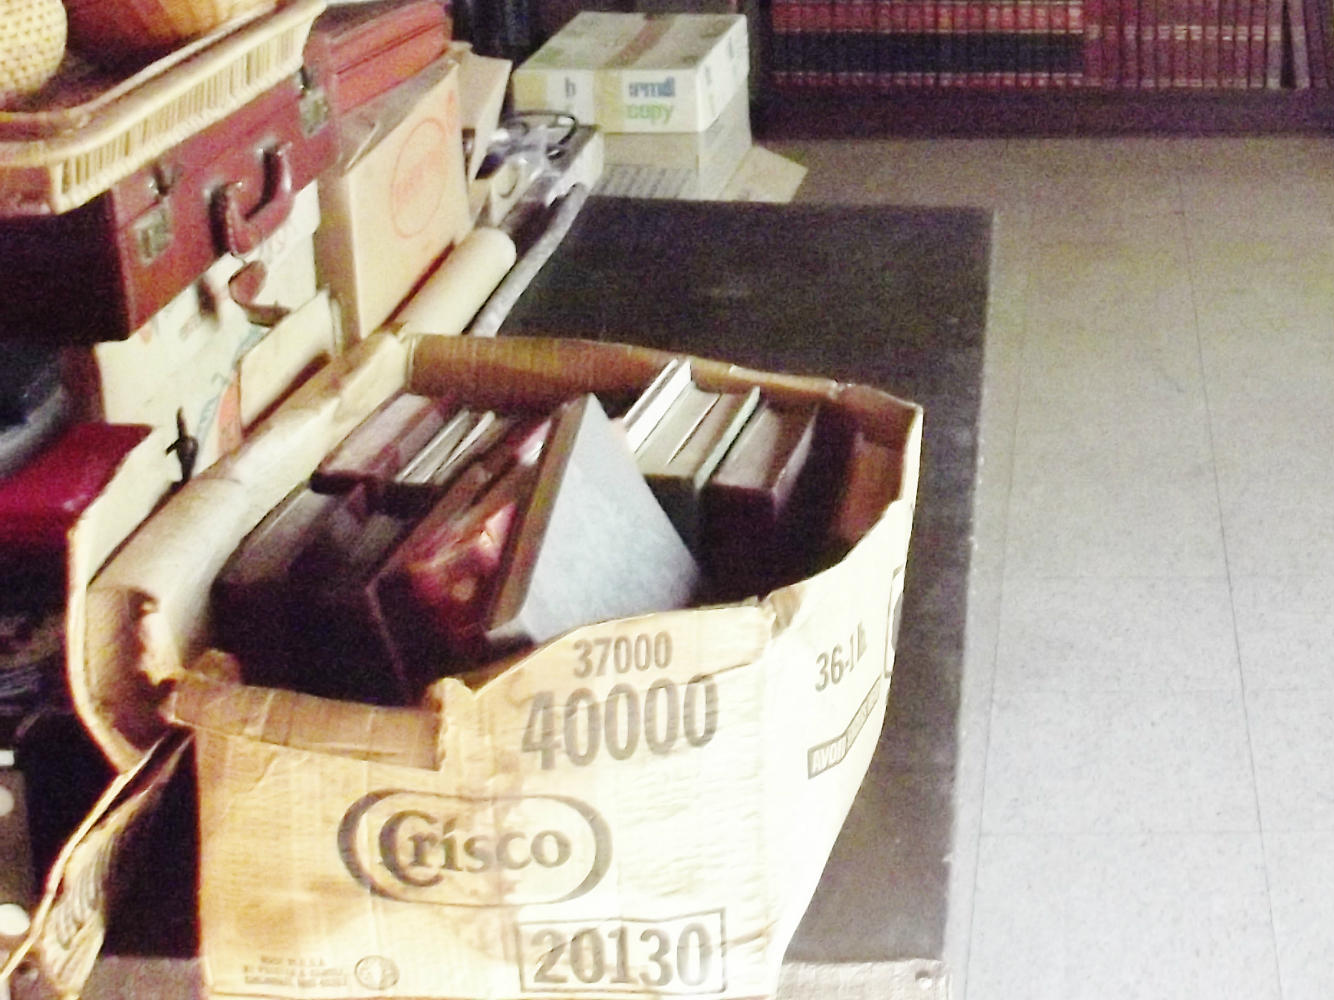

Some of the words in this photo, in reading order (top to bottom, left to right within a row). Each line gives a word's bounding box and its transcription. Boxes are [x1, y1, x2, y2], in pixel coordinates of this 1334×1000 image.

[572, 631, 673, 679] 37000
[521, 674, 719, 770] 40000
[378, 810, 572, 887] Crisco
[530, 923, 712, 986] 20130
